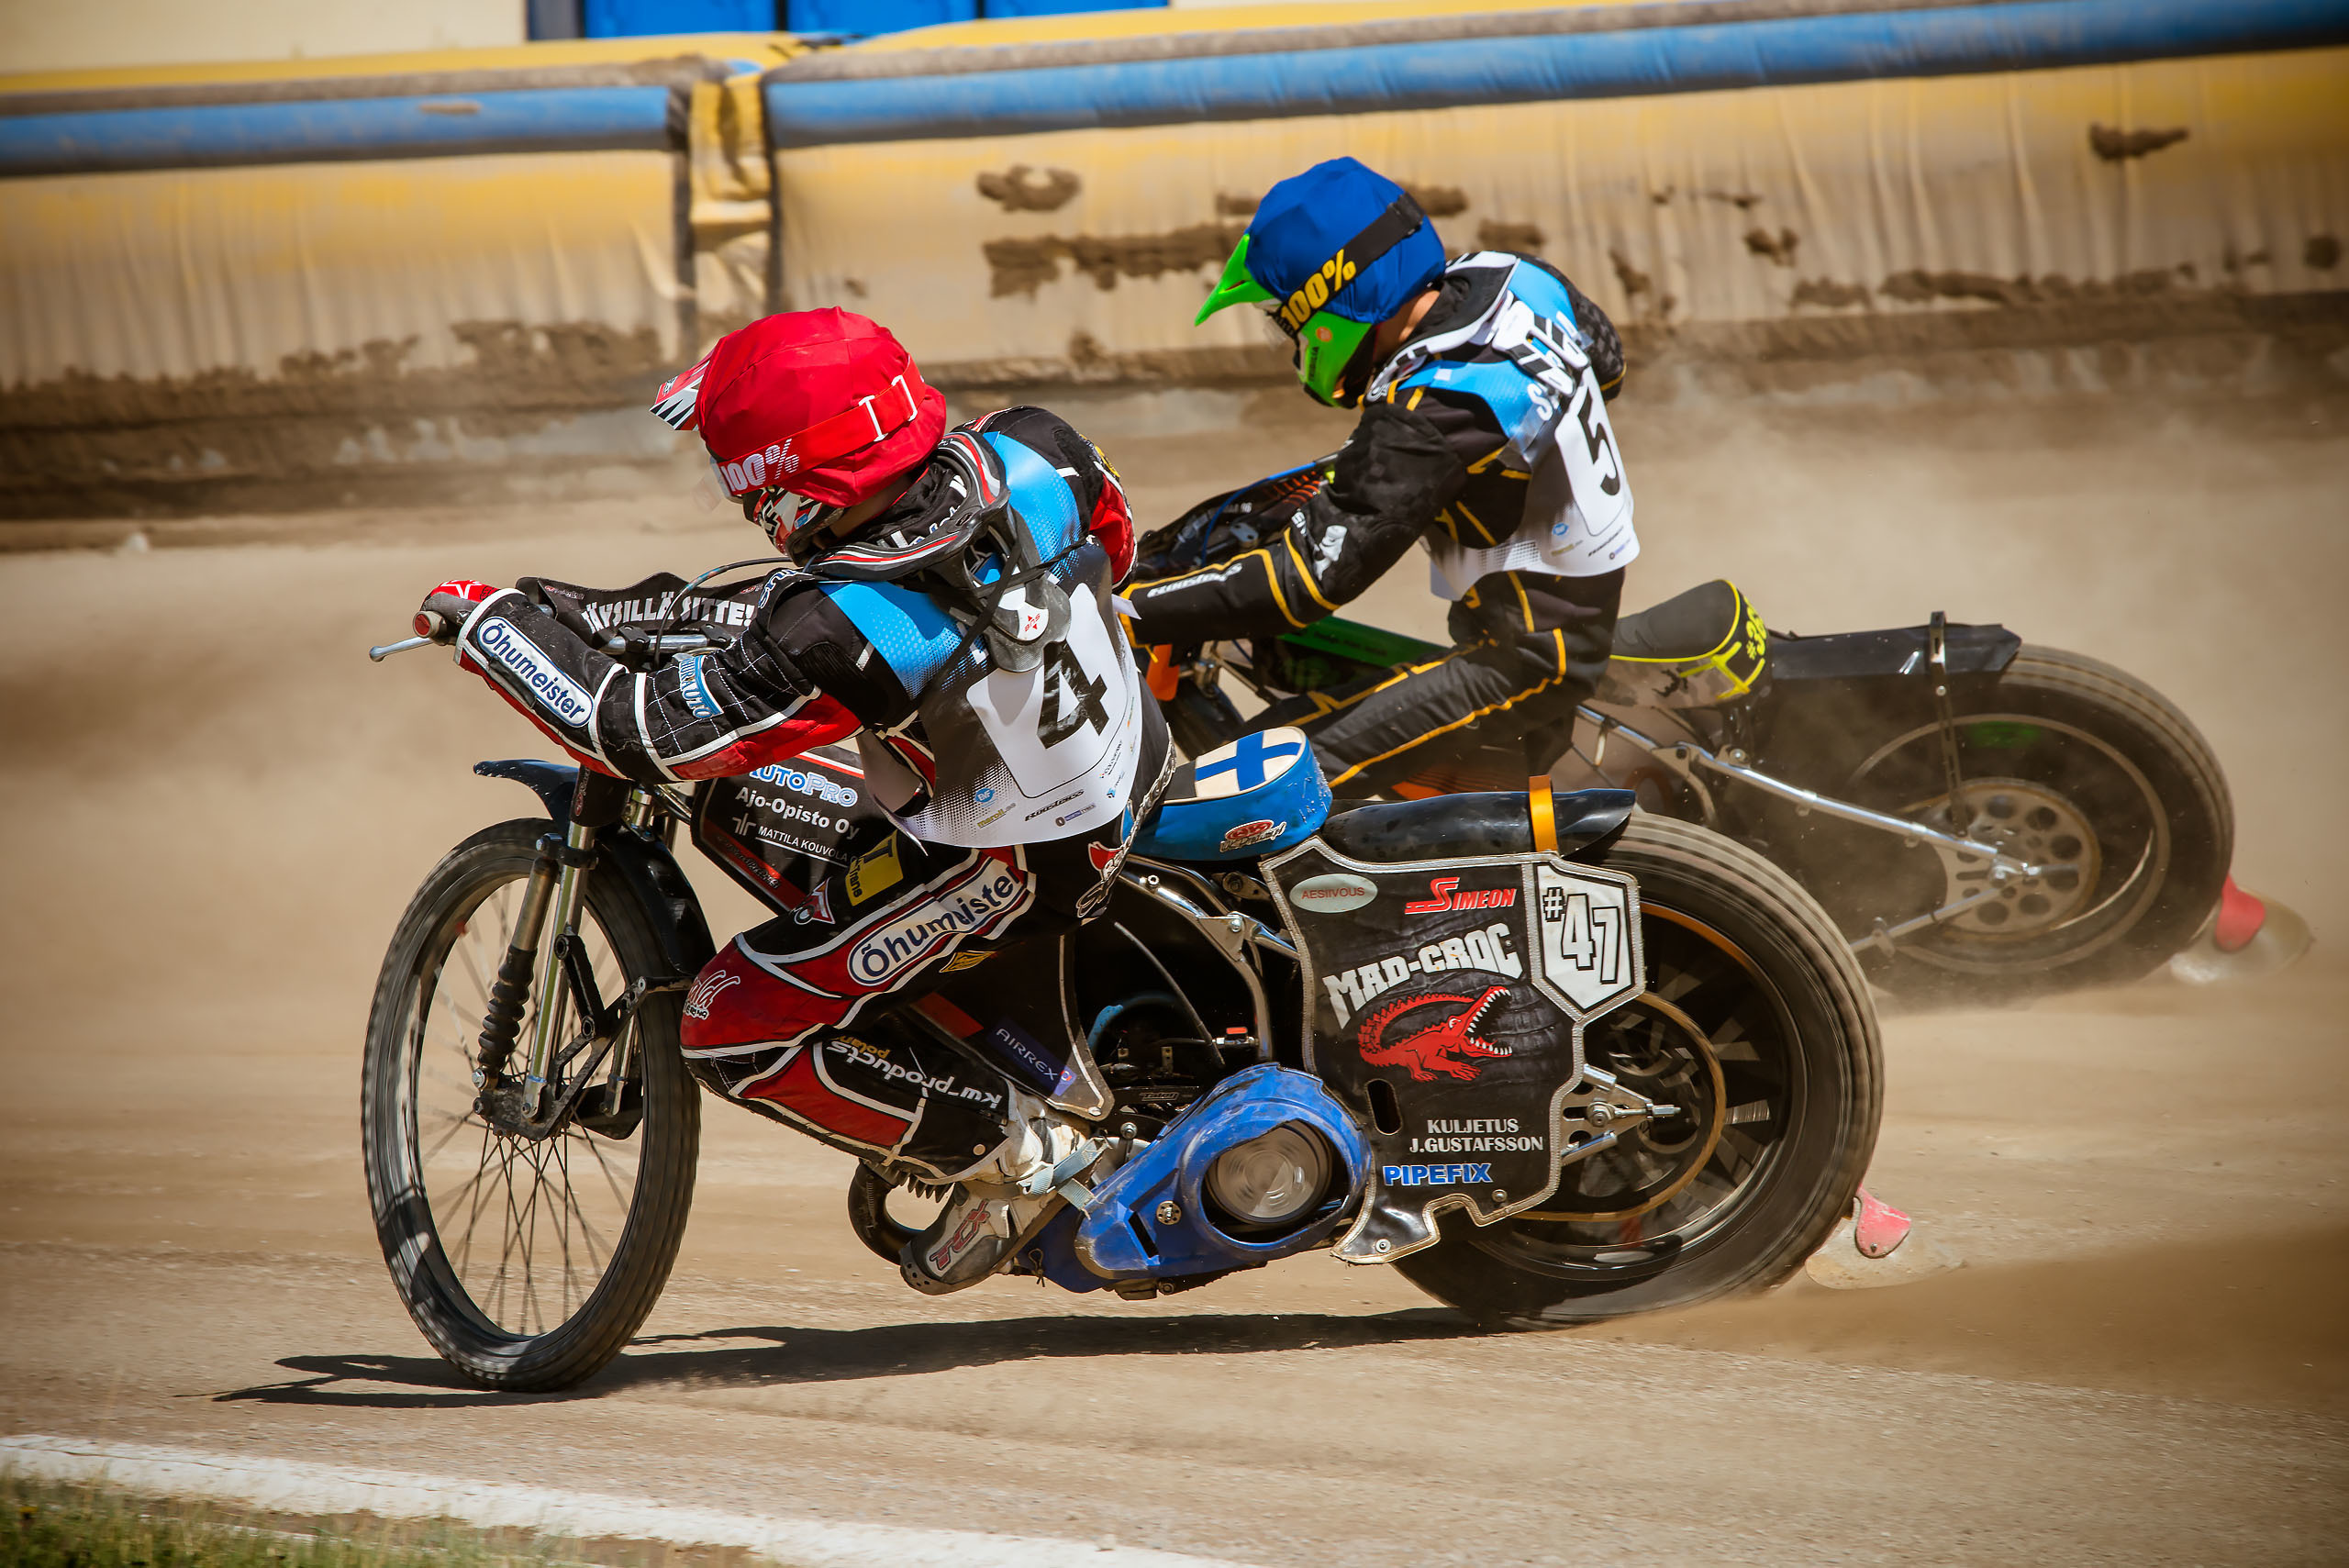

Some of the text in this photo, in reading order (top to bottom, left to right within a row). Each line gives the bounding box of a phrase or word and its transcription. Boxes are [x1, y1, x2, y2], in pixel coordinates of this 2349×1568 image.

[1281, 248, 1357, 331] 100%
[720, 439, 799, 492] 100%
[1577, 386, 1620, 495] 5
[680, 596, 755, 628] SITTE!
[482, 624, 585, 719] Õhumeister
[1037, 640, 1109, 749] 4
[735, 786, 861, 840] Ajo-Opisto Oy
[758, 826, 799, 847] MATTILA
[801, 839, 848, 862] KOUVOLA
[849, 864, 863, 898] Trans
[1301, 886, 1365, 899] AESIIVOUS
[1405, 876, 1517, 915] SIMEON
[1542, 886, 1621, 984] #47
[1322, 923, 1523, 1029] MAD-CROC
[826, 1040, 1003, 1109] kw-products
[995, 1027, 1060, 1082] AIRREX
[1409, 1136, 1544, 1153] J.GUSTAFSSON
[1427, 1118, 1520, 1134] KULJETUS
[1382, 1162, 1494, 1186] PIPEFIX
[930, 1199, 991, 1270] TCX
